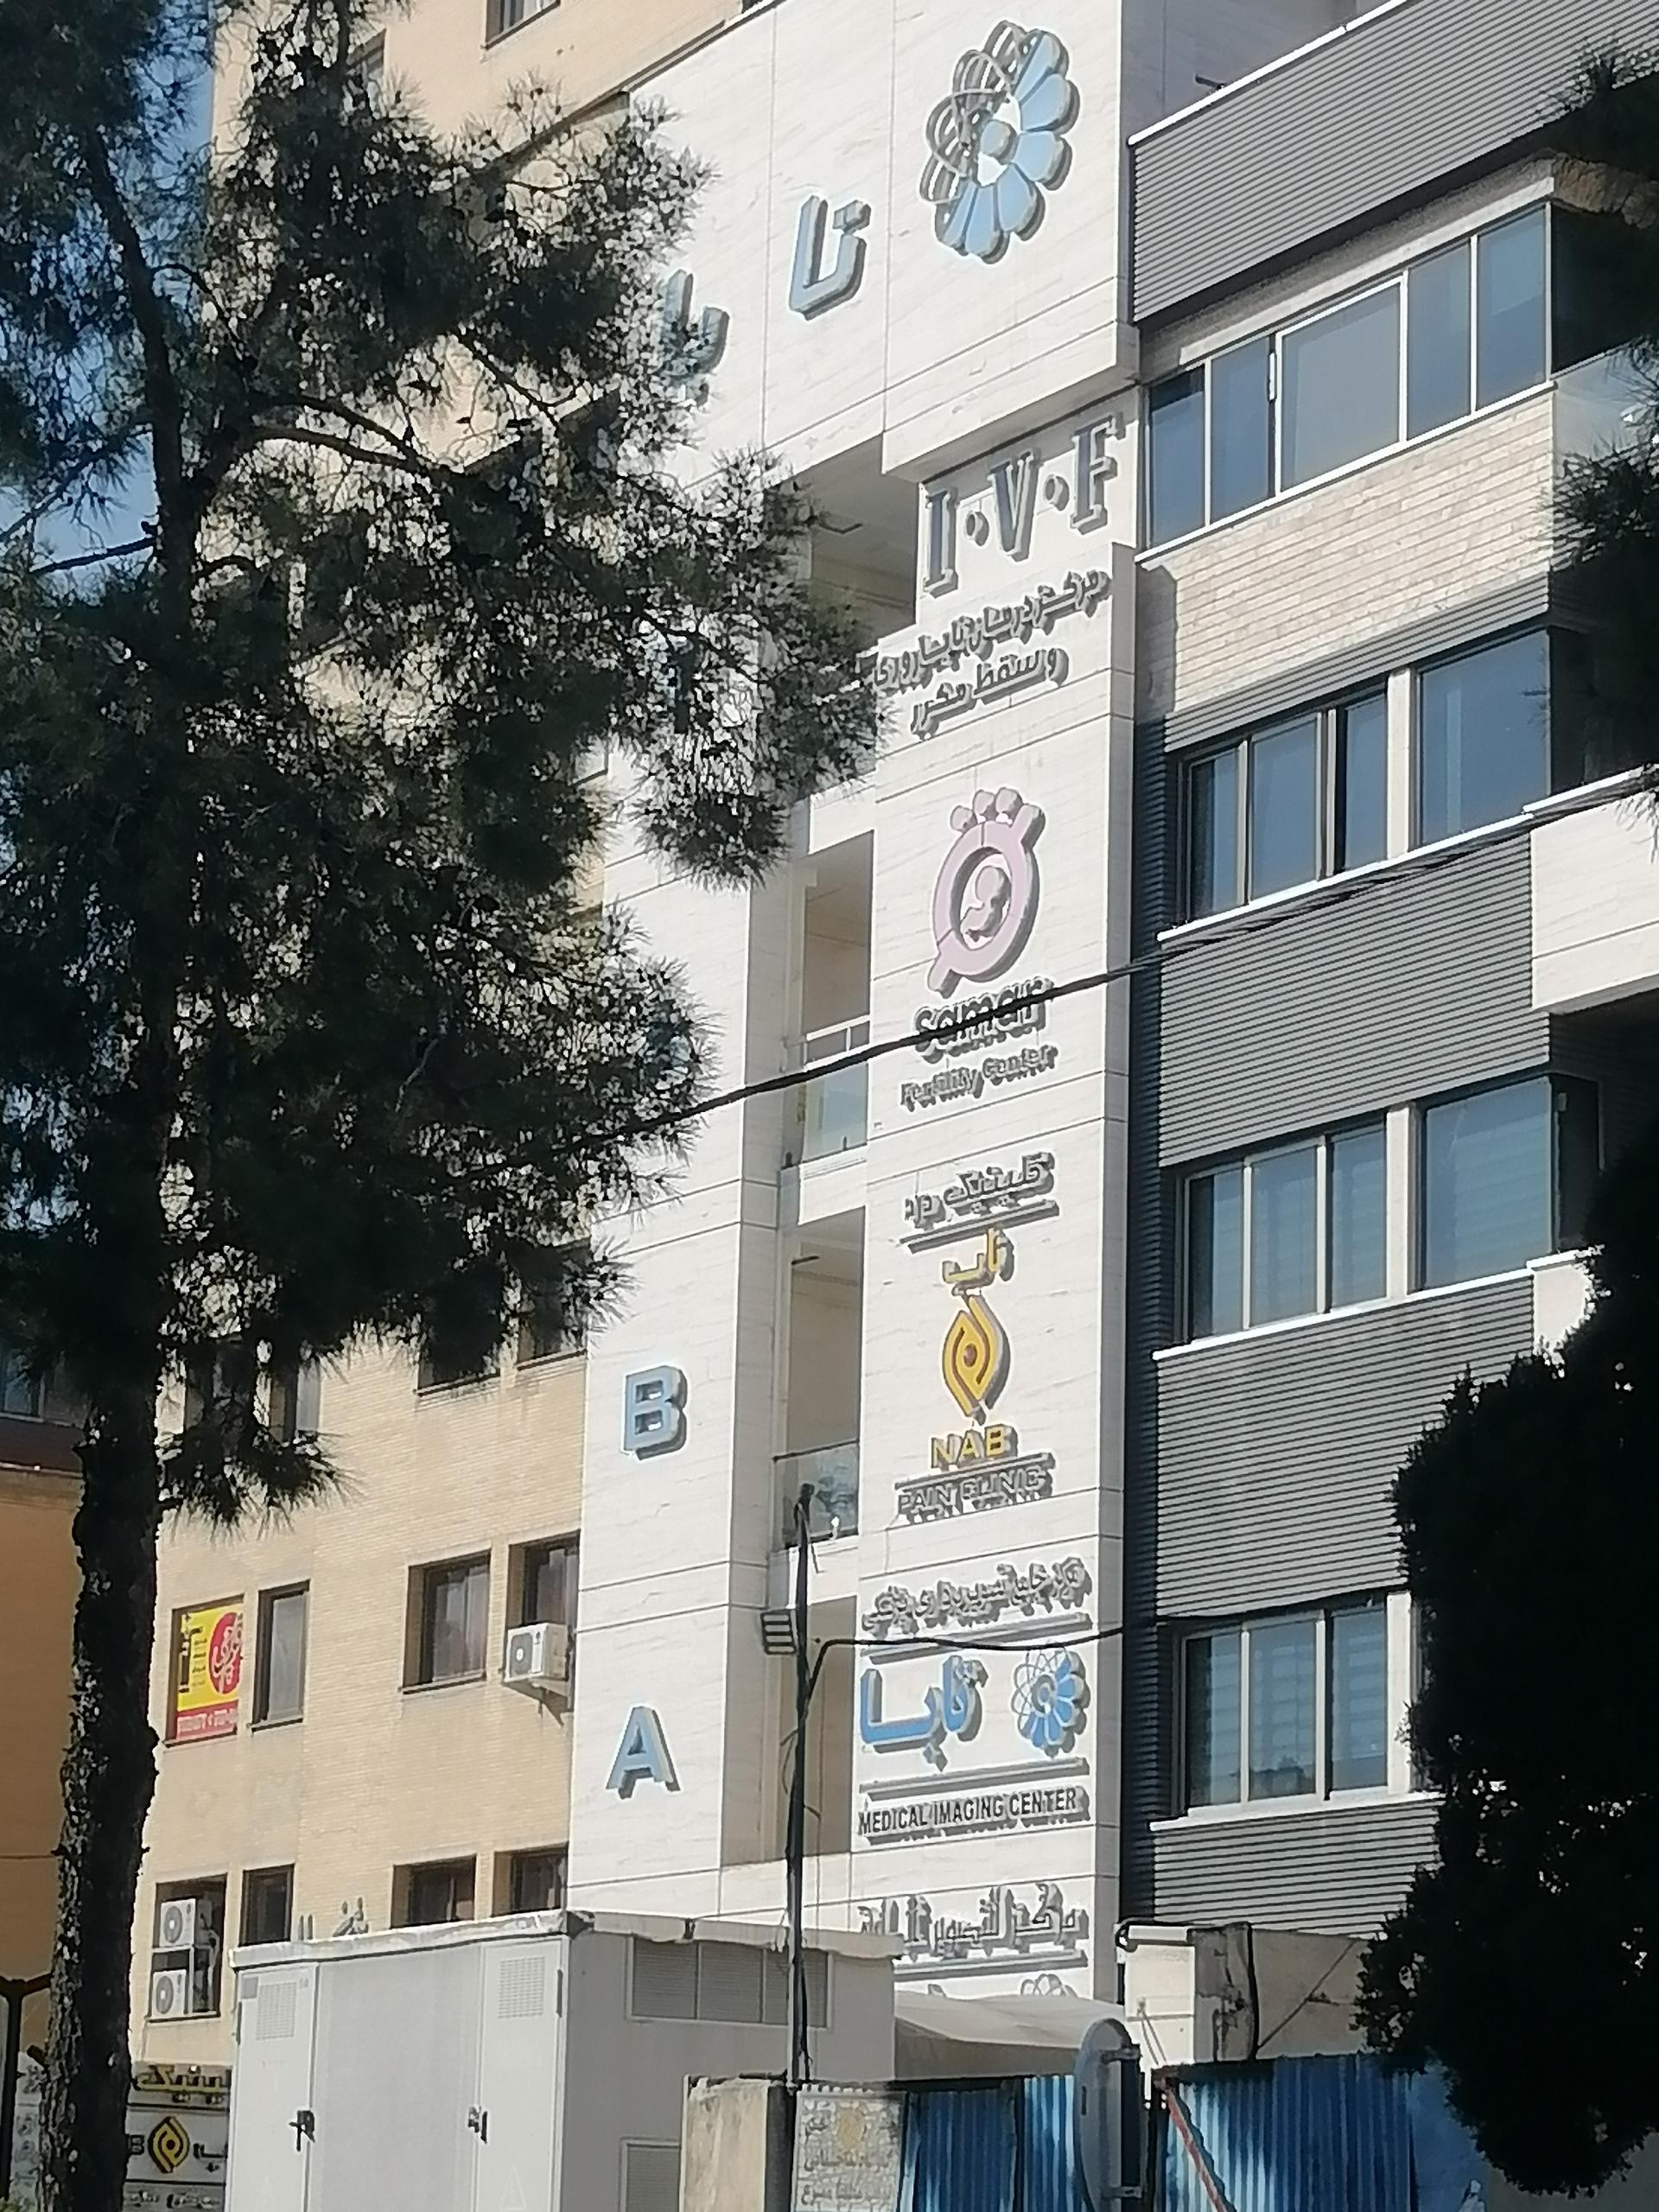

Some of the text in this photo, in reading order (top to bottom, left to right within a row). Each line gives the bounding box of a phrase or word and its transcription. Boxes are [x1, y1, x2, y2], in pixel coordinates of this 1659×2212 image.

[1033, 569, 1112, 635] مرکز
[900, 1044, 1058, 1112] Fertility Center
[943, 1151, 1055, 1217] کلینیک
[931, 1423, 1018, 1471] NAB
[897, 1464, 1052, 1522] PAIN CLINIC
[857, 1785, 1083, 1838] MEDICAL IMAGING CENTER
